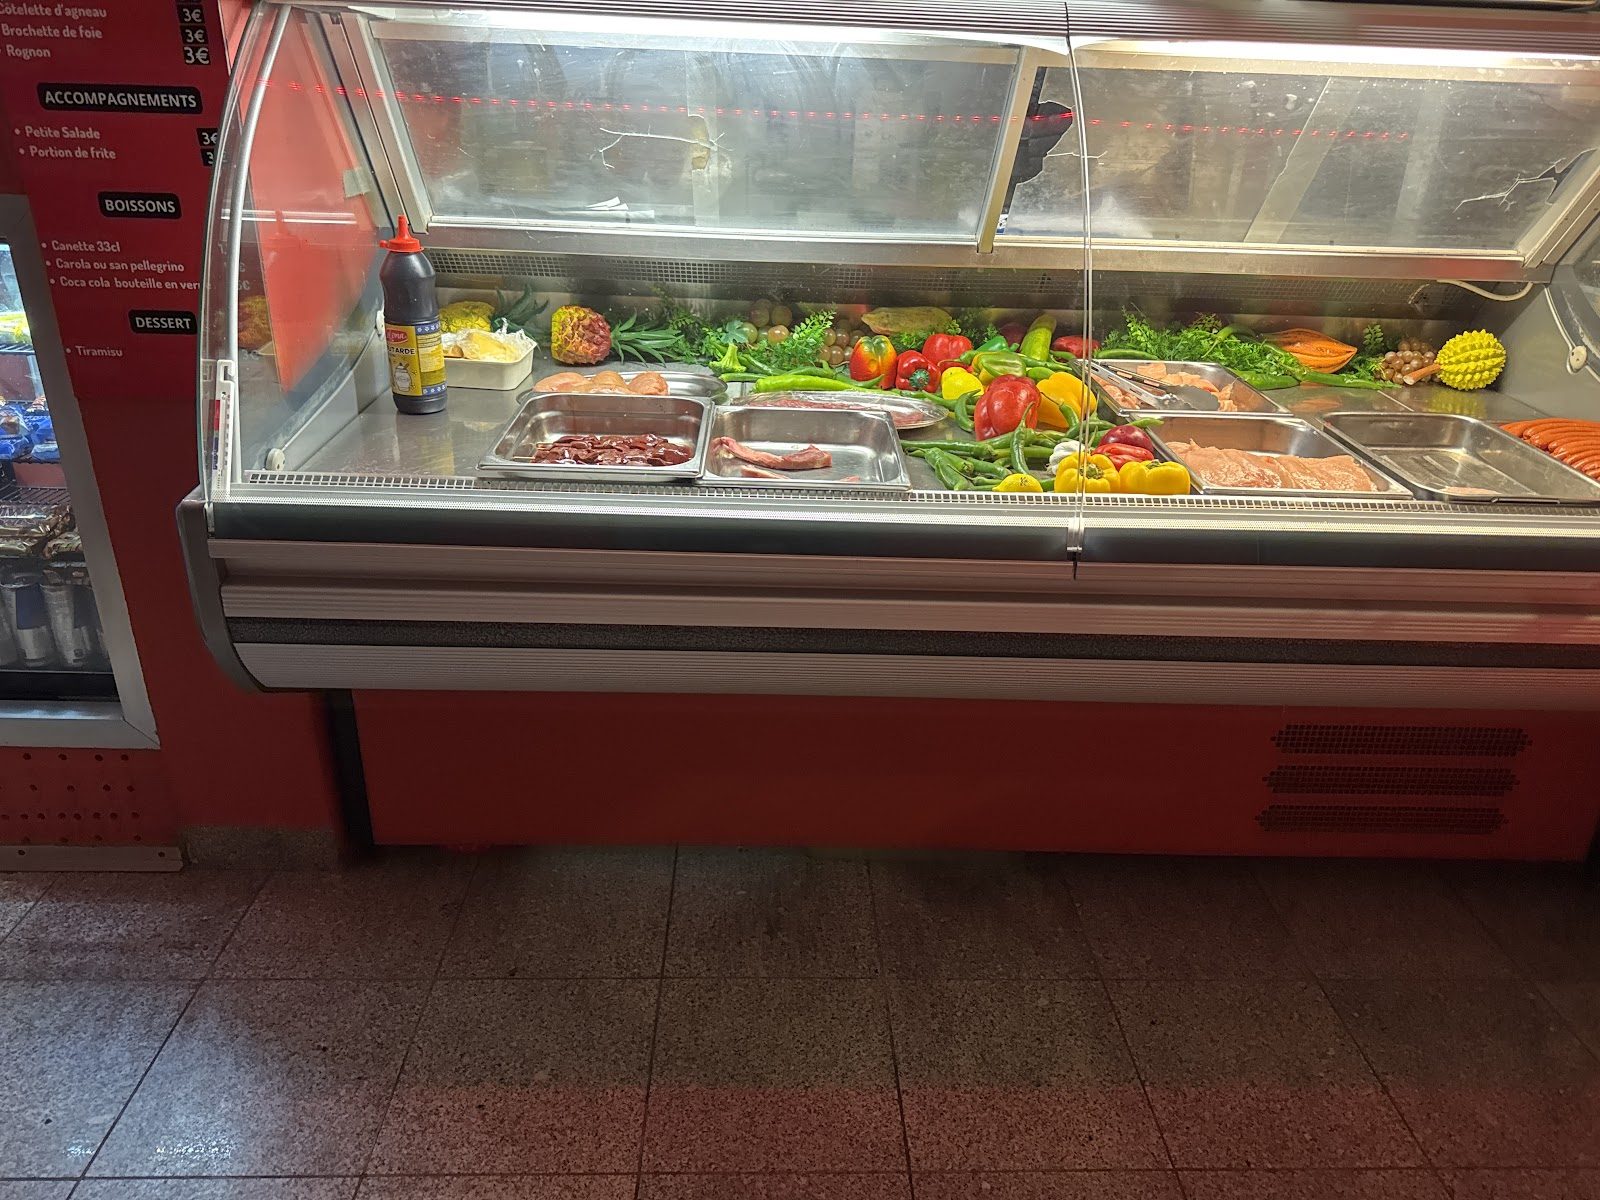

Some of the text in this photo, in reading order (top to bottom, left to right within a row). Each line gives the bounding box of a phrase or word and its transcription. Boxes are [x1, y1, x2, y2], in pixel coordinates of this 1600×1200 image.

[0, 2, 108, 20] Côtelette d'agneau
[182, 8, 202, 22] 3€
[1, 23, 103, 39] Brochette de foie
[185, 29, 205, 43] 3€
[6, 44, 51, 60] Rognon
[184, 46, 209, 64] 3€
[45, 91, 197, 108] ACCOMPAGNEMENTS
[25, 125, 101, 140] Petite Salade
[30, 146, 116, 160] Portion de frite
[105, 199, 176, 213] BOISSONS
[52, 240, 121, 253] Canette 33cl
[56, 259, 185, 274] Carola ou san pellegrino
[60, 276, 86, 287] Coca
[88, 277, 111, 288] cola
[115, 277, 163, 289] bouteille
[165, 281, 178, 290] en
[135, 317, 191, 330] DESSERT
[75, 346, 123, 357] Tiramisu
